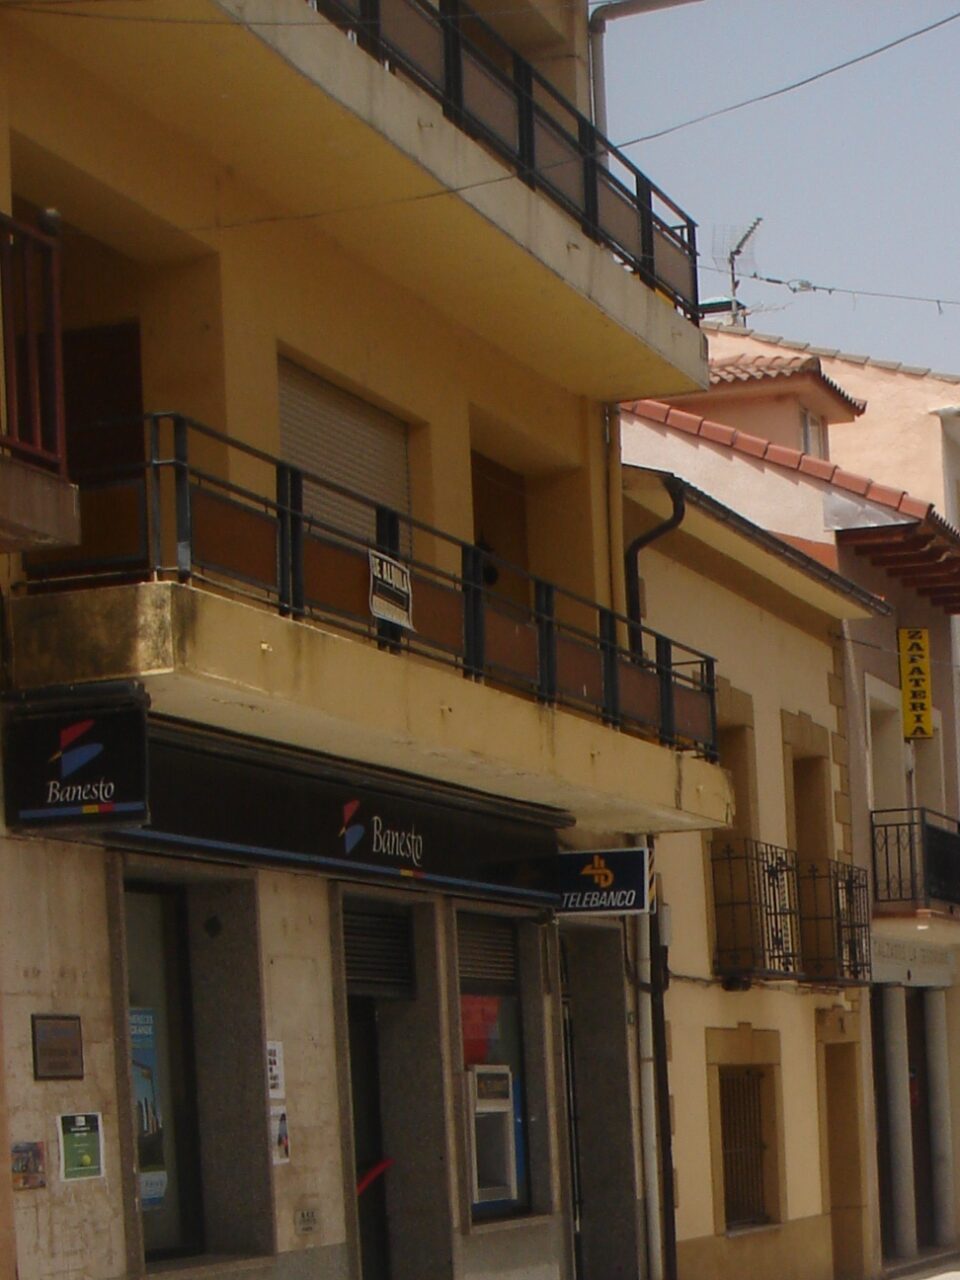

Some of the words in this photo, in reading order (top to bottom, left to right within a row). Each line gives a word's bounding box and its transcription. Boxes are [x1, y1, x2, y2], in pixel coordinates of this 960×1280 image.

[907, 630, 928, 736] ZAPATERIA
[47, 777, 115, 803] Banesto
[371, 815, 423, 868] Banesto
[562, 889, 636, 908] TELEBANCO
